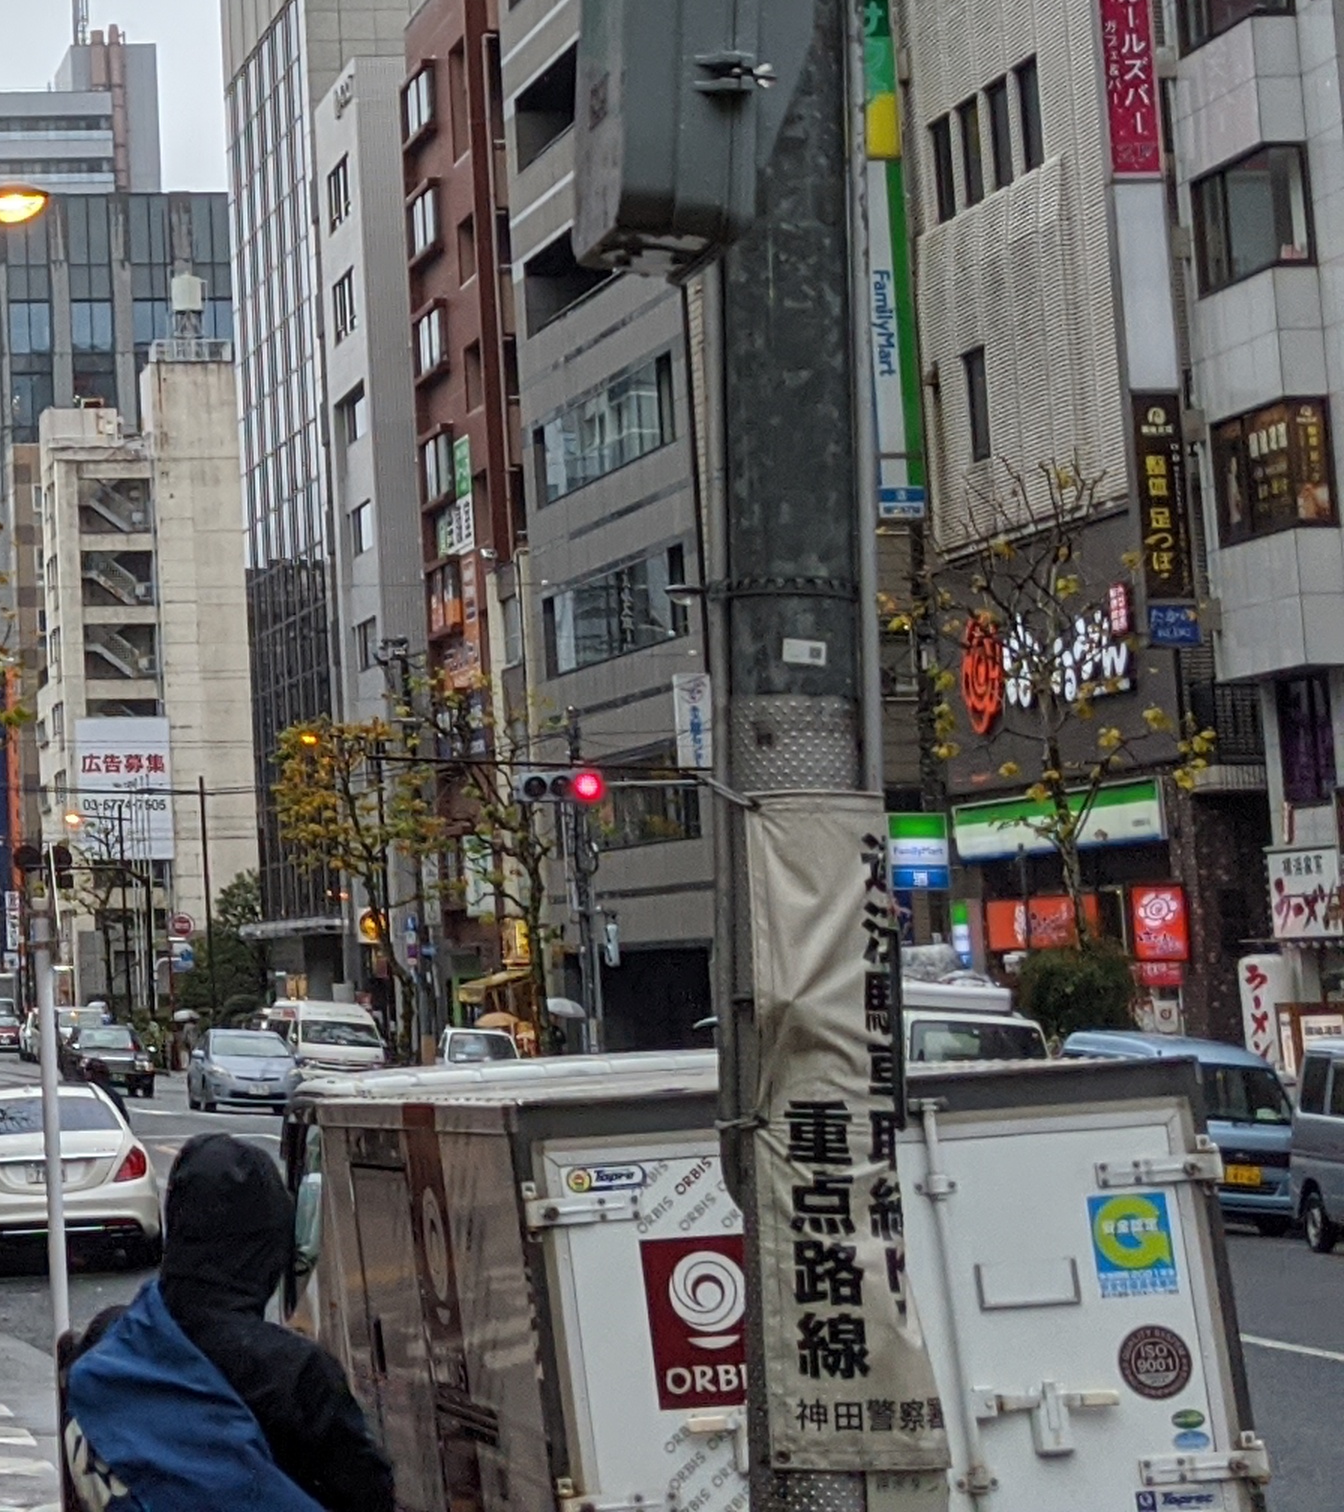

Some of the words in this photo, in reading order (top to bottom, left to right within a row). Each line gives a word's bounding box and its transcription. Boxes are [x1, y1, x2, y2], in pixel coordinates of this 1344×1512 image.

[871, 270, 896, 376] FamilyMart
[81, 753, 166, 775] 広告募集
[1244, 963, 1272, 1062] ラーメン
[675, 1157, 713, 1196] ORBIS
[637, 1196, 674, 1234] ORBIS
[679, 1192, 717, 1232] ORBIS
[782, 1100, 869, 1380] 重点路線
[1137, 1357, 1174, 1372] 9001
[1140, 1344, 1167, 1358] ISO
[666, 1364, 747, 1395] ORBI
[669, 1451, 707, 1490] ORBIS
